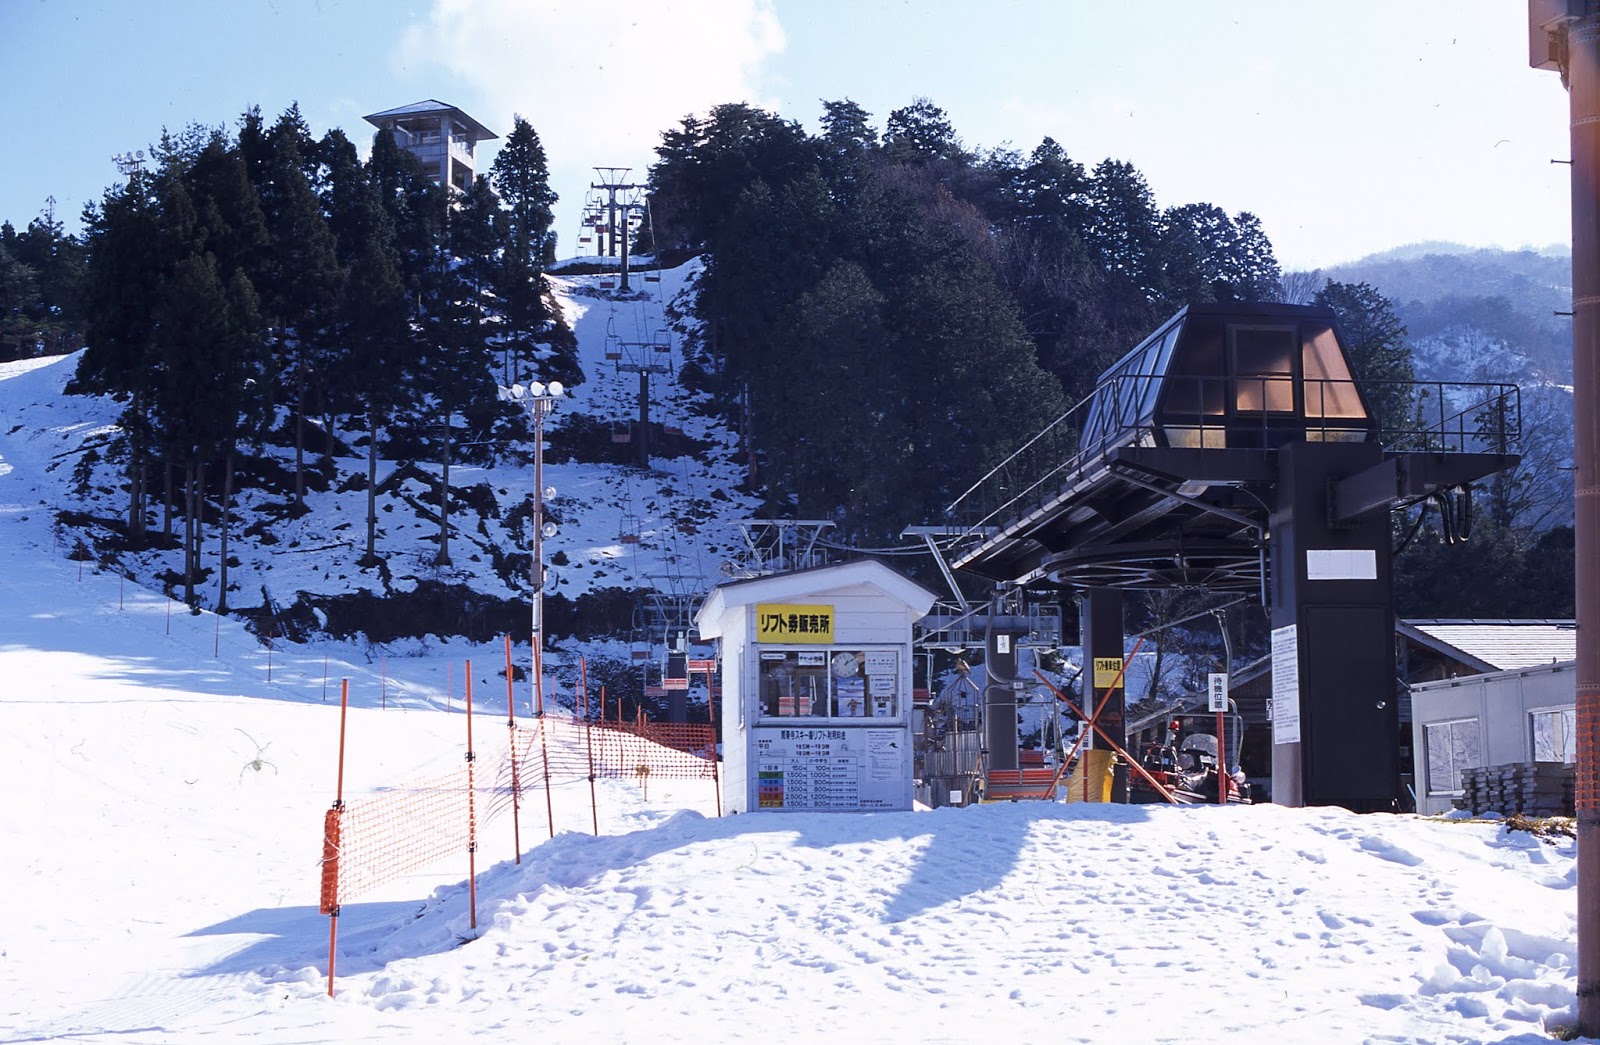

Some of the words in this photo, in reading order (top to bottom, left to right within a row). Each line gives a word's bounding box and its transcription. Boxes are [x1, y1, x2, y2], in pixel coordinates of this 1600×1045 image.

[761, 614, 829, 633] リフト券販売所
[1214, 677, 1222, 708] 待機位置
